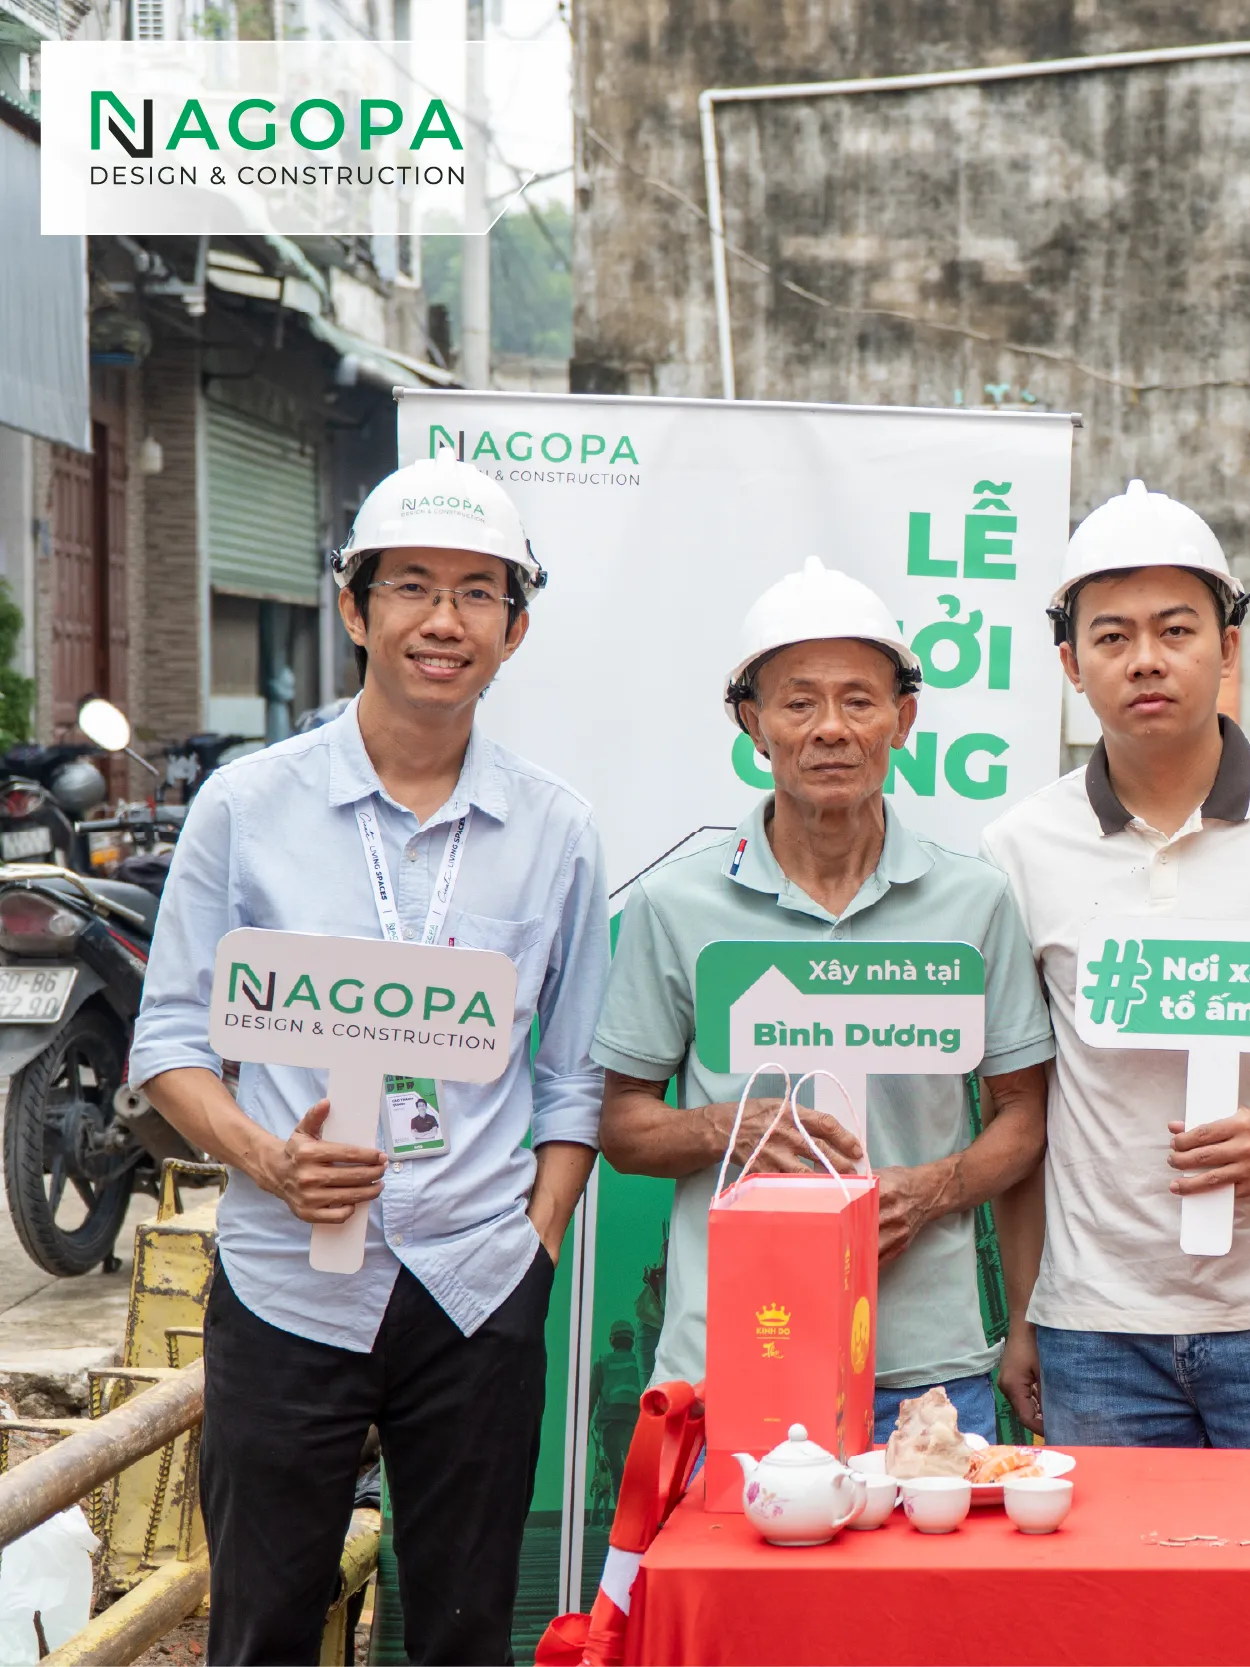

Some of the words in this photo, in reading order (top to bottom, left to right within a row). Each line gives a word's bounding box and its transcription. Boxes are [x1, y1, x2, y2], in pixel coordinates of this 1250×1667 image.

[495, 470, 504, 482] &
[509, 470, 640, 486] CONSTRUCTION
[401, 495, 485, 516] NAGOPA
[907, 480, 1017, 580] LỄ
[731, 731, 1010, 800] CNG
[447, 844, 459, 868] LIVING
[369, 845, 380, 870] LIVING
[375, 871, 388, 901] SPACES
[808, 959, 859, 985] Xây
[867, 960, 917, 981] nhà
[925, 959, 960, 986] tại
[1163, 954, 1219, 982] Nơi
[228, 962, 496, 1027] NAGOPA
[1160, 990, 1196, 1020] tổ
[225, 1013, 303, 1033] DESIGN
[312, 1021, 324, 1035] &
[332, 1023, 496, 1050] CONSTRUCTION
[754, 1021, 834, 1046] Bình
[845, 1023, 960, 1053] Dương
